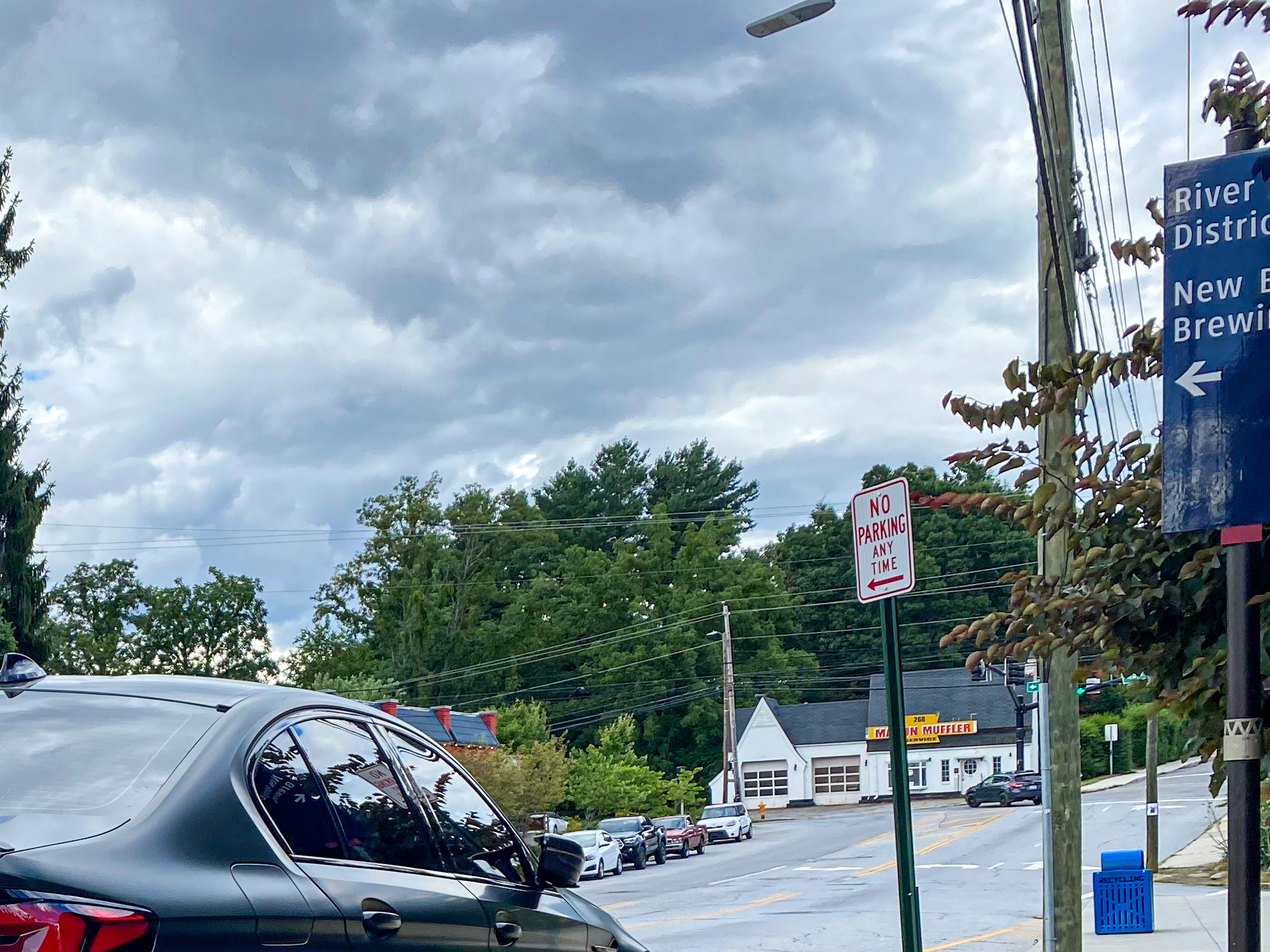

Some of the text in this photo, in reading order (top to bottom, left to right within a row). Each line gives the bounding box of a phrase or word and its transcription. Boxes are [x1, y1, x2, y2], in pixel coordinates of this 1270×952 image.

[1174, 178, 1256, 213] River
[1174, 276, 1243, 307] New
[1174, 303, 1270, 343] Brewi
[869, 494, 891, 518] NO
[858, 513, 906, 546] PARKING
[872, 540, 894, 559] ANY
[871, 556, 898, 576] TIME
[922, 723, 971, 735] MUFFLER
